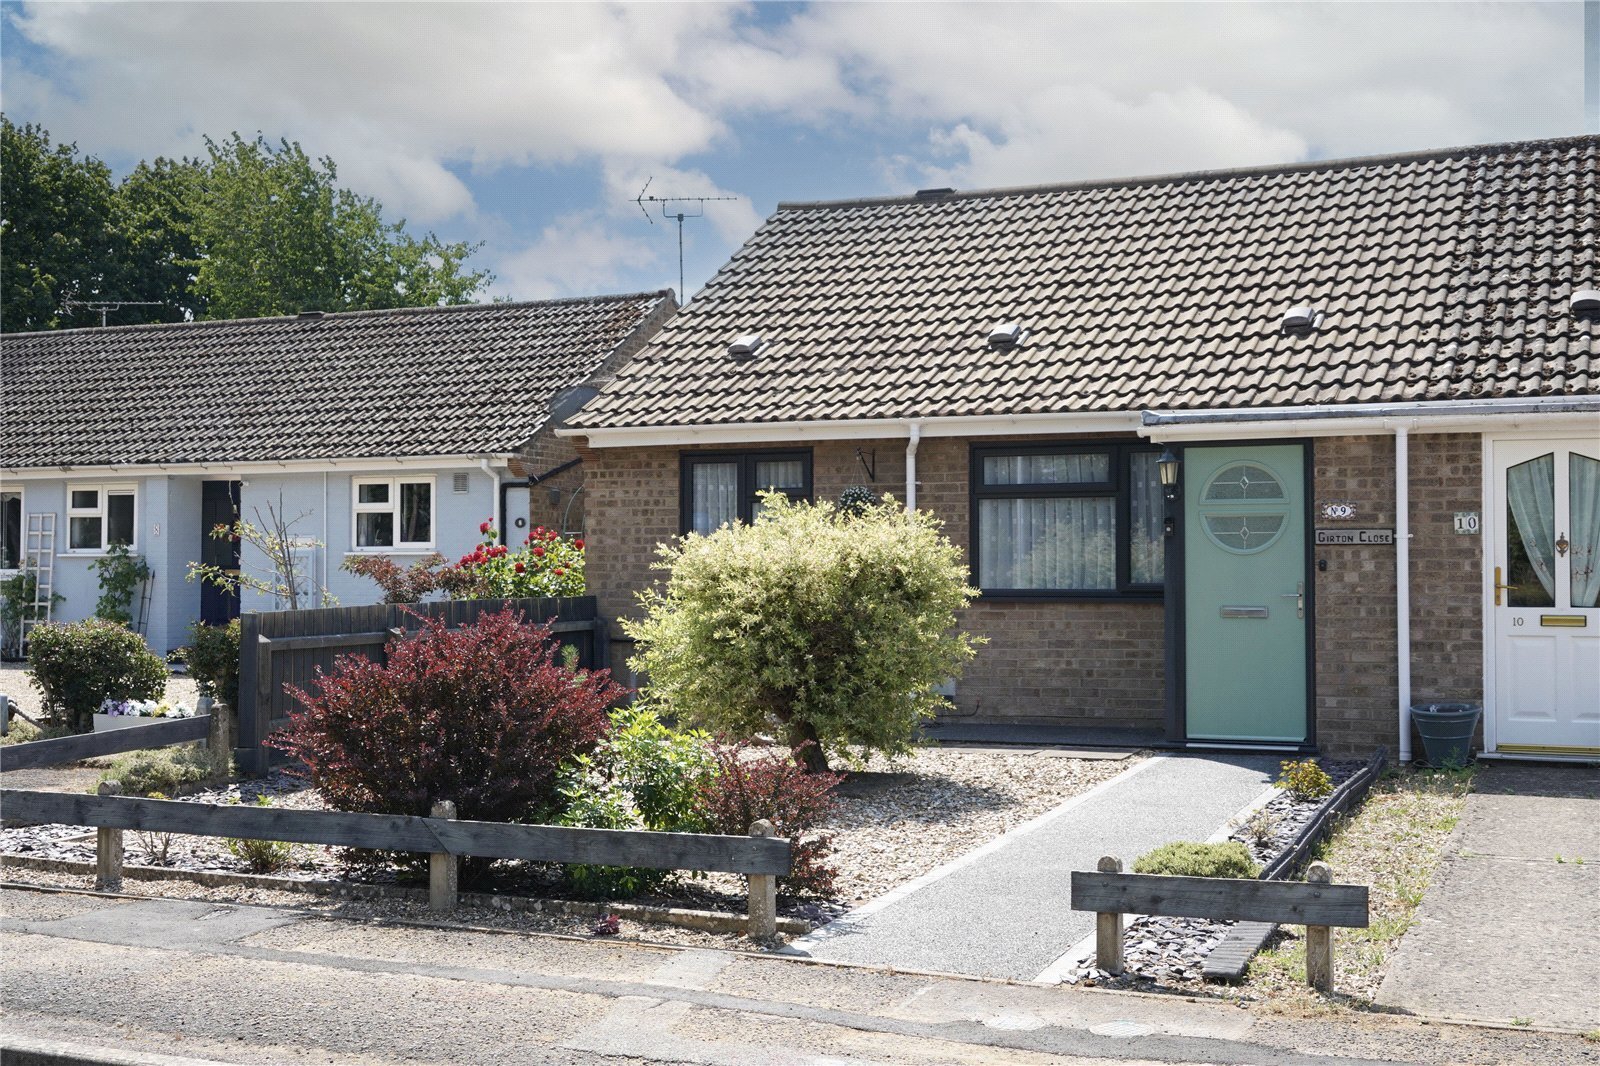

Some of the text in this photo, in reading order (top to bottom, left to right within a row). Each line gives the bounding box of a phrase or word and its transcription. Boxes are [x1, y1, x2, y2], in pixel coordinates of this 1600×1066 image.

[1340, 506, 1347, 515] 9
[1456, 517, 1477, 529] 10
[1318, 531, 1390, 543] GIRTON CLOSE
[1513, 617, 1524, 626] 10
